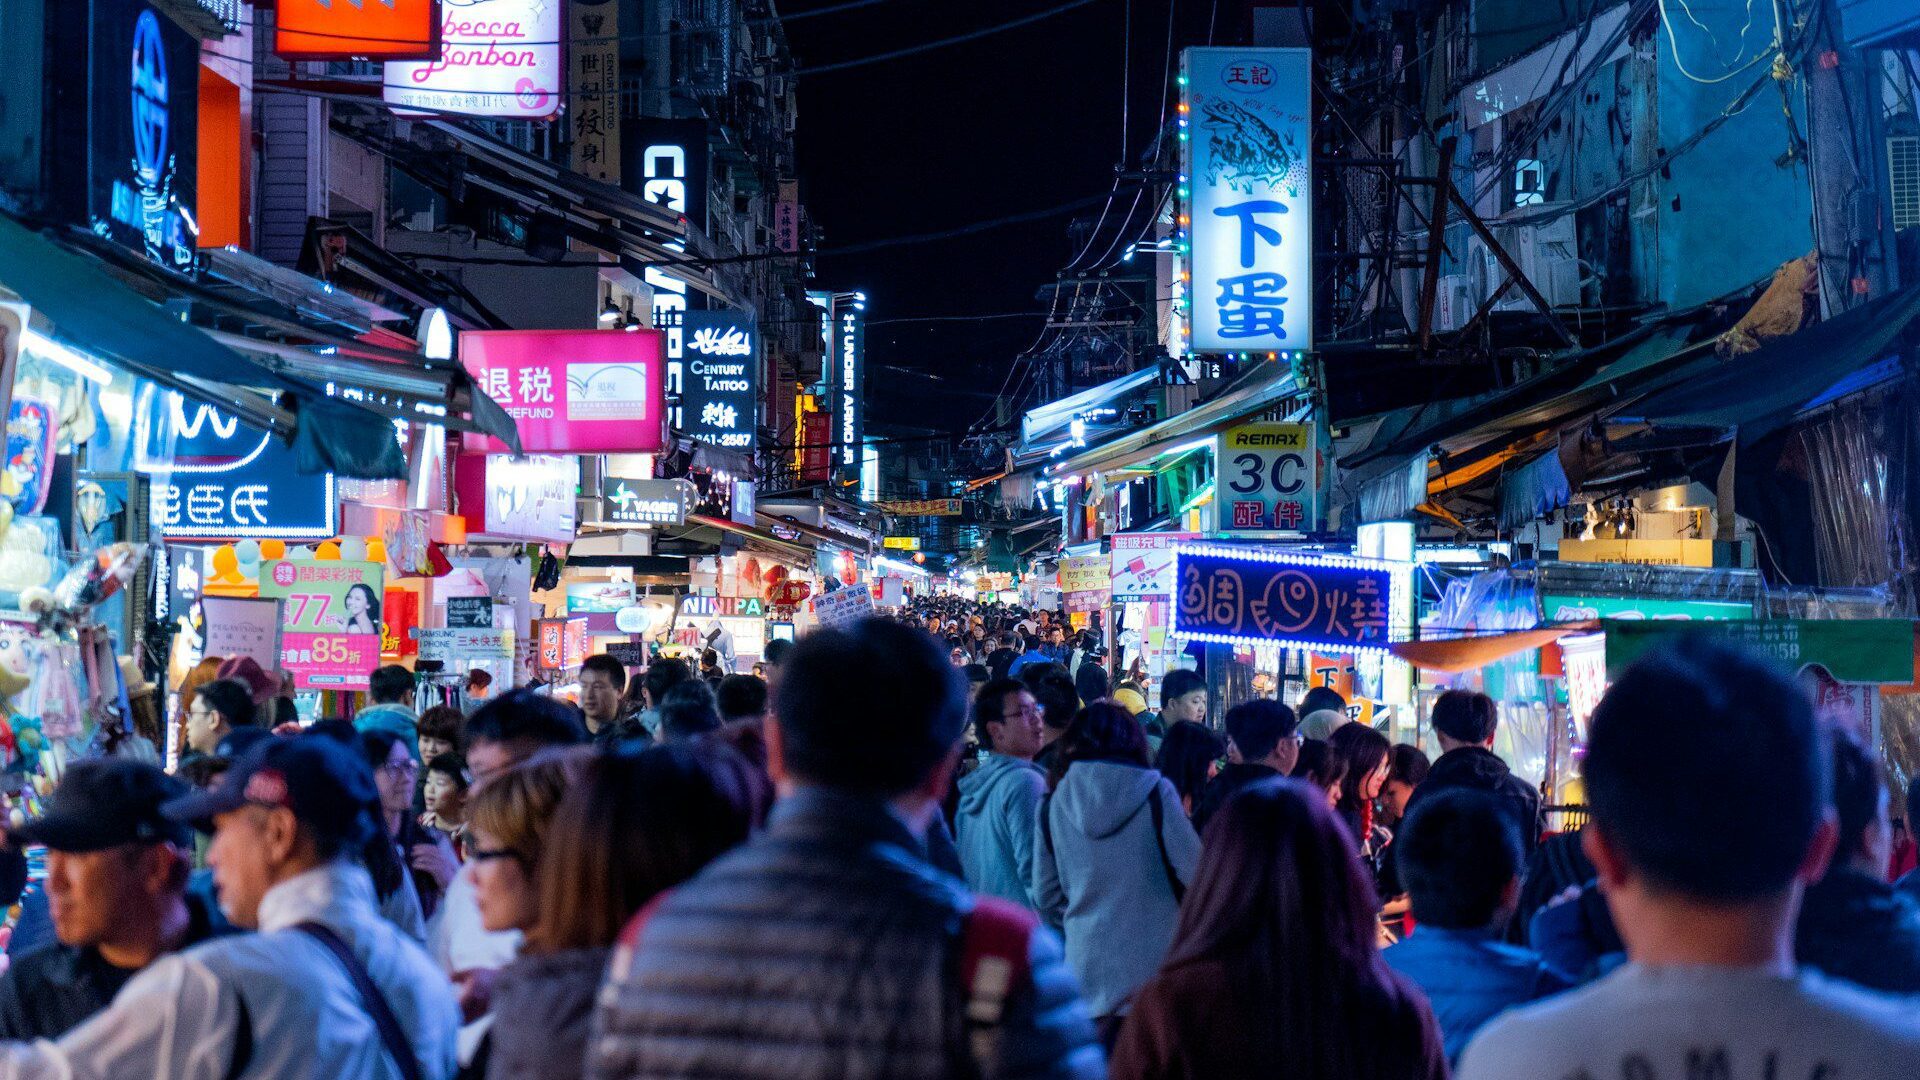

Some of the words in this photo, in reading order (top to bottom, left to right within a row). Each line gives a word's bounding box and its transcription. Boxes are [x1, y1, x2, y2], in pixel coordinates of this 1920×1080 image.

[412, 40, 536, 83] Bonbon
[1227, 66, 1271, 85] 王記
[1213, 200, 1289, 340] 下蛋
[844, 336, 854, 391] UNDER
[689, 433, 751, 447] 61-2587
[1236, 432, 1299, 446] REMAX
[1229, 453, 1307, 495] 3C
[1233, 500, 1303, 528] 配件
[684, 597, 761, 616] NINIPA
